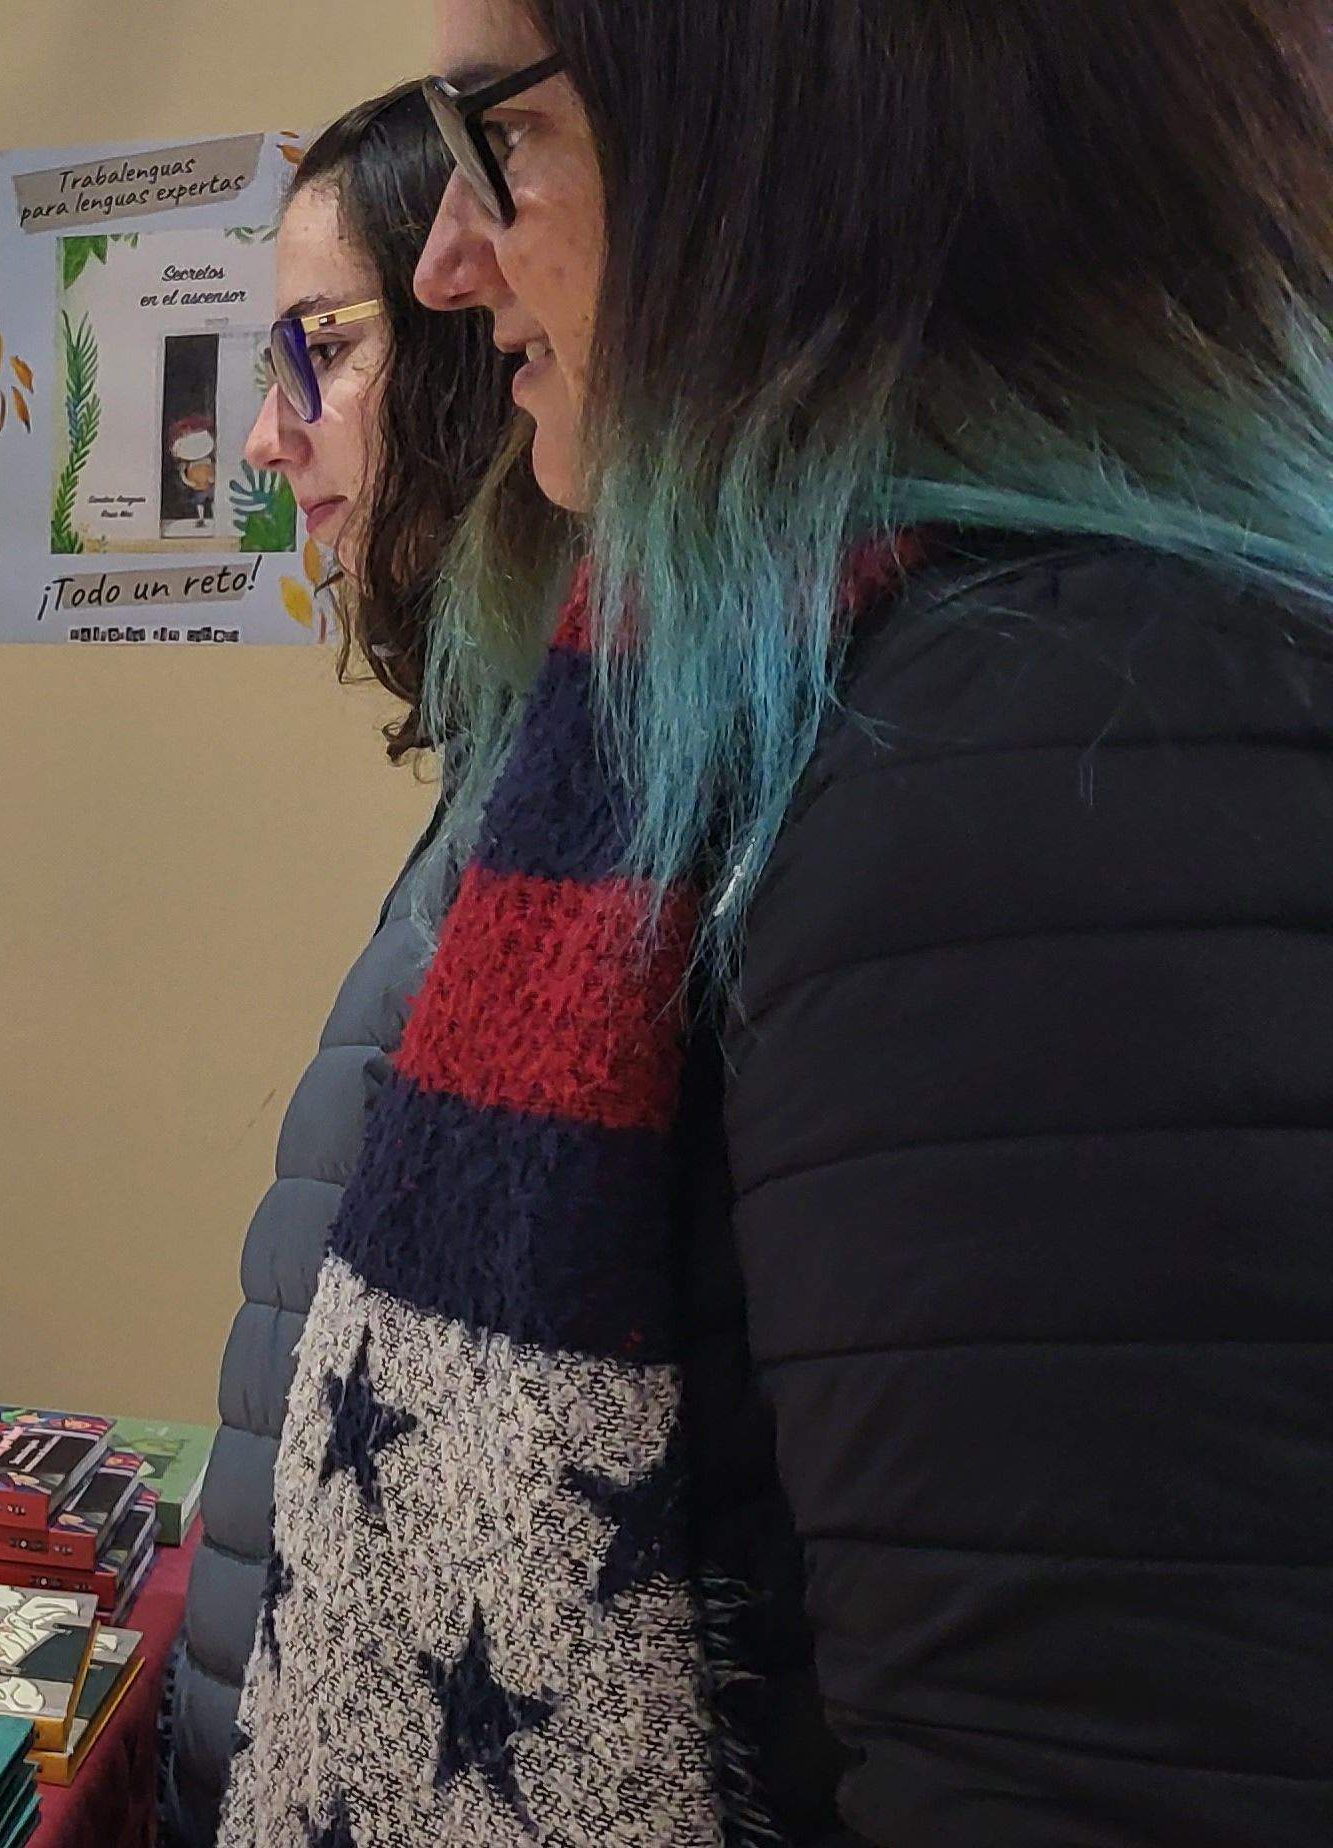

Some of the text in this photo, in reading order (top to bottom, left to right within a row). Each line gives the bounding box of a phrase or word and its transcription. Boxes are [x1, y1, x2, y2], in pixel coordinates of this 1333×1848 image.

[59, 156, 196, 193] Trabalenguas
[19, 175, 245, 225] para lenguas expertas
[162, 263, 225, 283] Secretos
[140, 289, 248, 307] en el ascensor
[36, 555, 262, 621] ¡Todo un reto!
